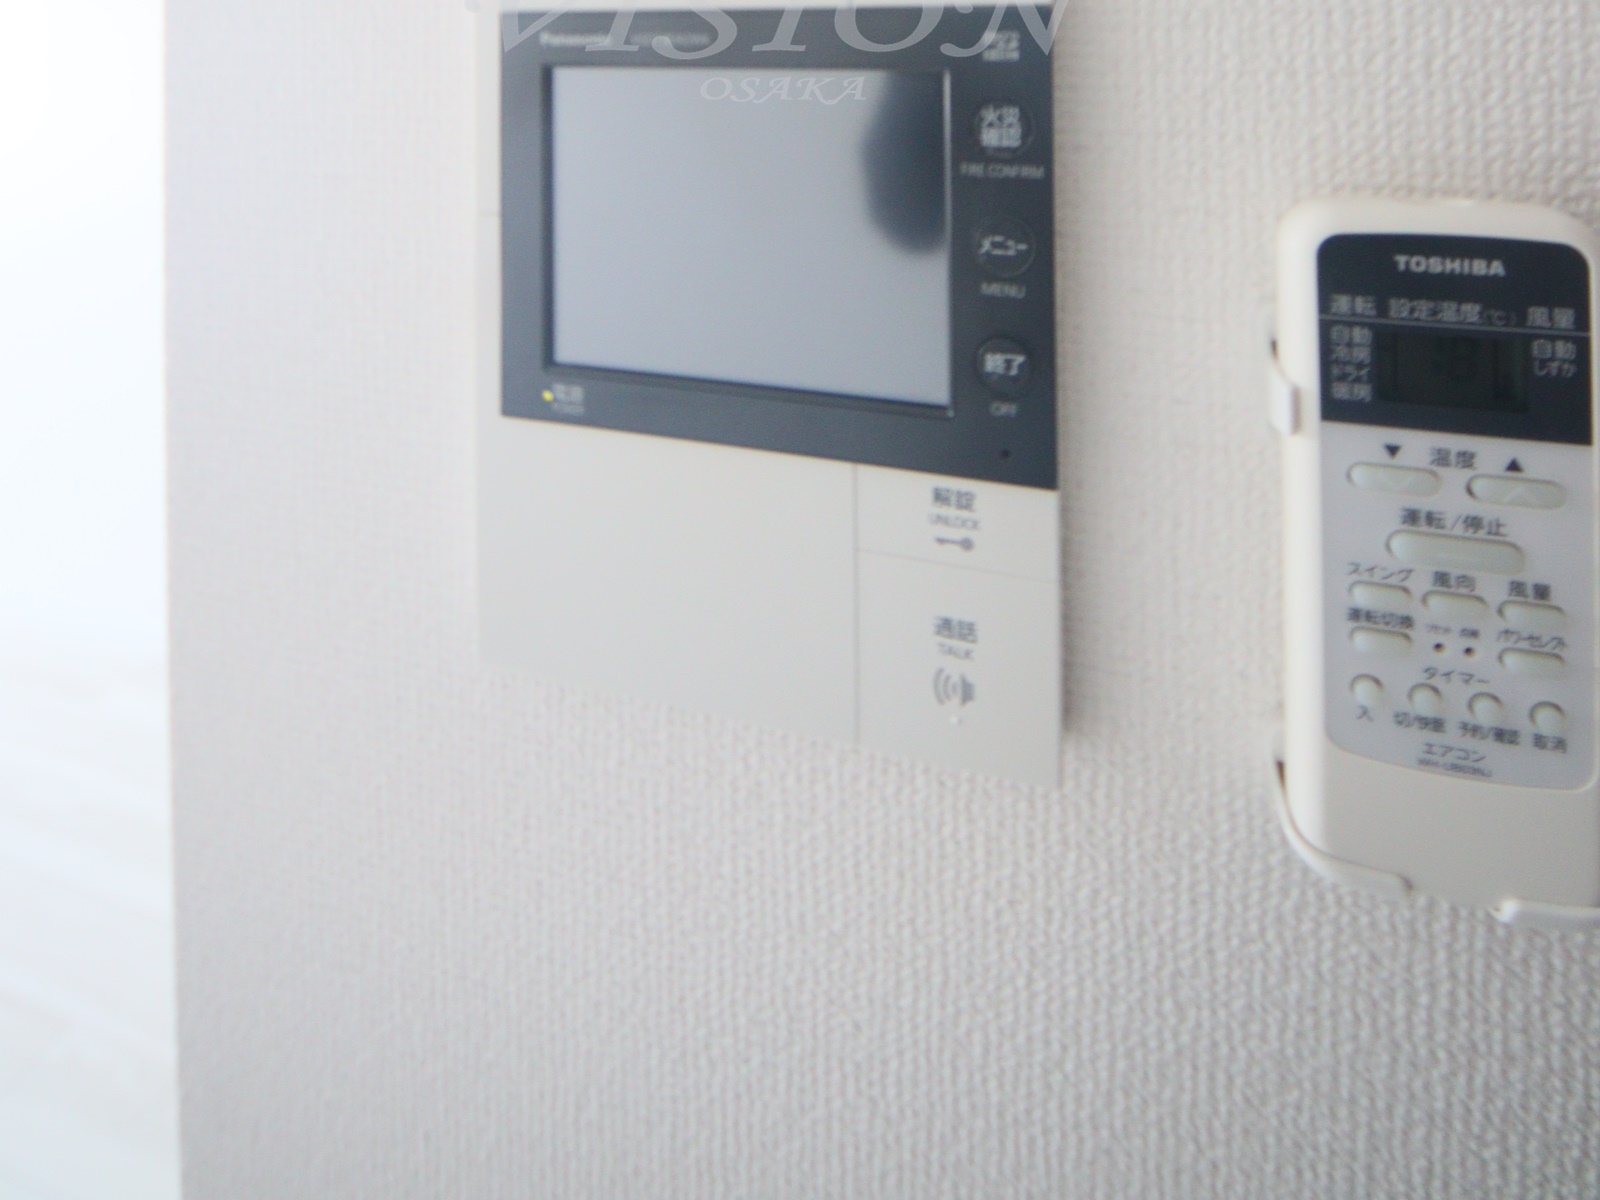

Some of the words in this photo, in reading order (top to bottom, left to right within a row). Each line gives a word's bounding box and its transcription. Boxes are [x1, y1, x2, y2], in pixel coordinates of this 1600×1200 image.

[979, 234, 1029, 256] メニュー
[1393, 254, 1507, 277] TOSHIBA
[980, 281, 1027, 299] MENU
[1329, 325, 1373, 346] 自動
[1531, 339, 1578, 360] 自動
[1532, 359, 1578, 378] しずか
[1430, 447, 1477, 470] 温度
[1400, 507, 1508, 538] 運転/停止
[1346, 562, 1416, 583] スイング
[1432, 570, 1477, 593] 風向
[1422, 666, 1490, 685] タイマー
[1422, 743, 1486, 763] エアコン
